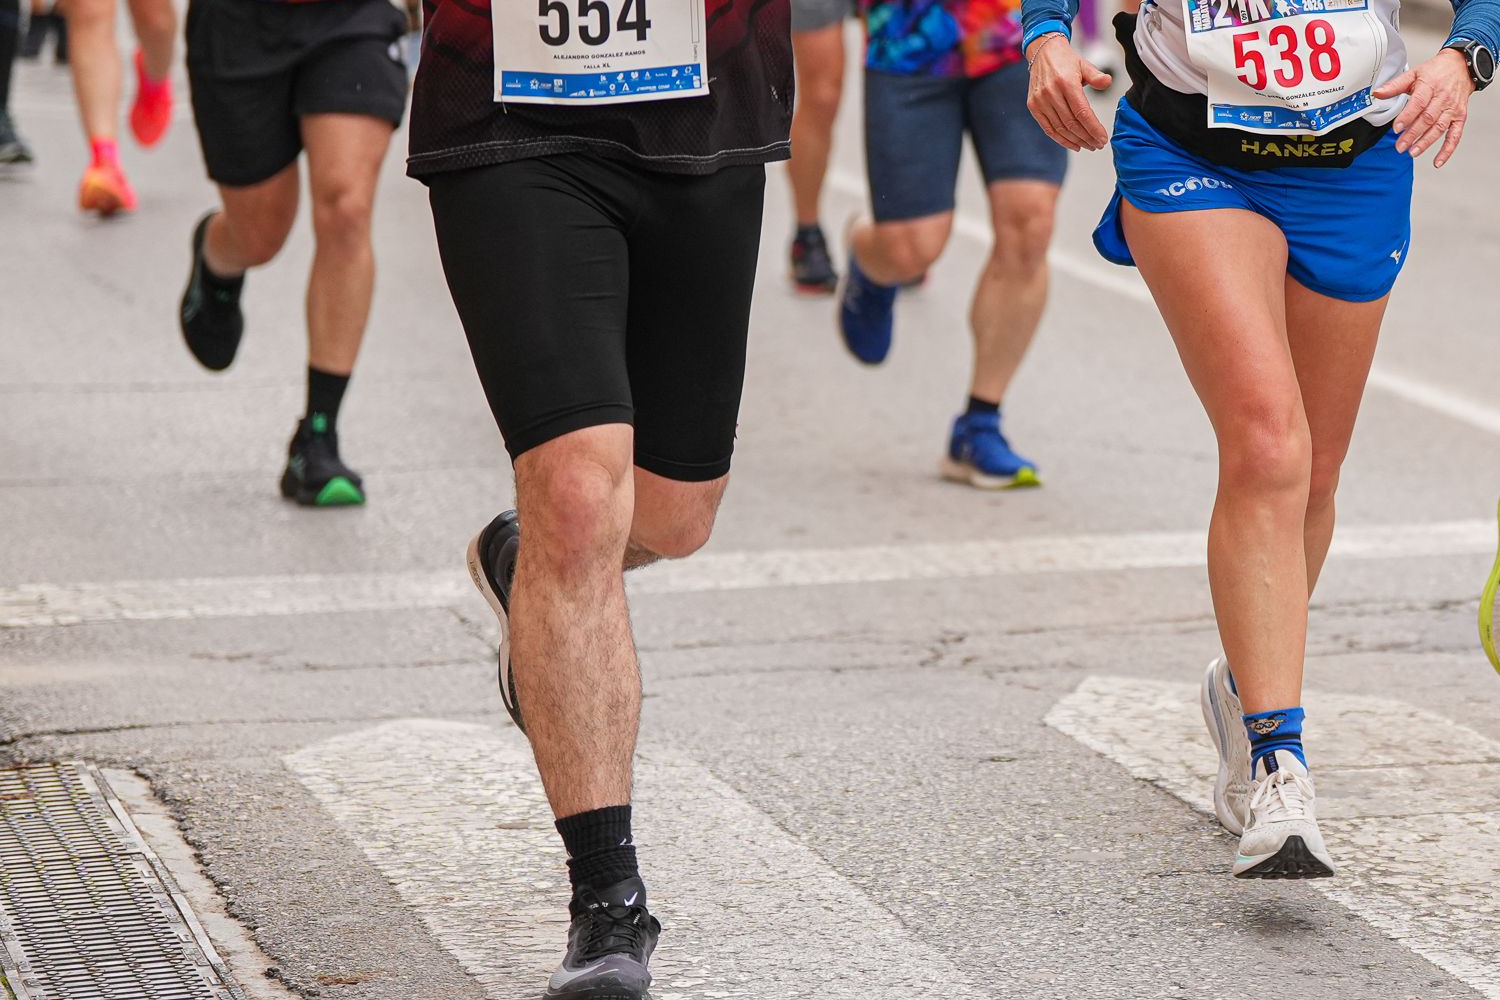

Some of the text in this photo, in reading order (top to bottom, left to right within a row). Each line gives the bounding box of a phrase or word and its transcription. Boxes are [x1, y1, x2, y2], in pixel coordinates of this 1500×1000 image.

[1302, 0, 1324, 11] 2026
[1232, 19, 1341, 91] 538
[1241, 138, 1354, 158] HANKER
